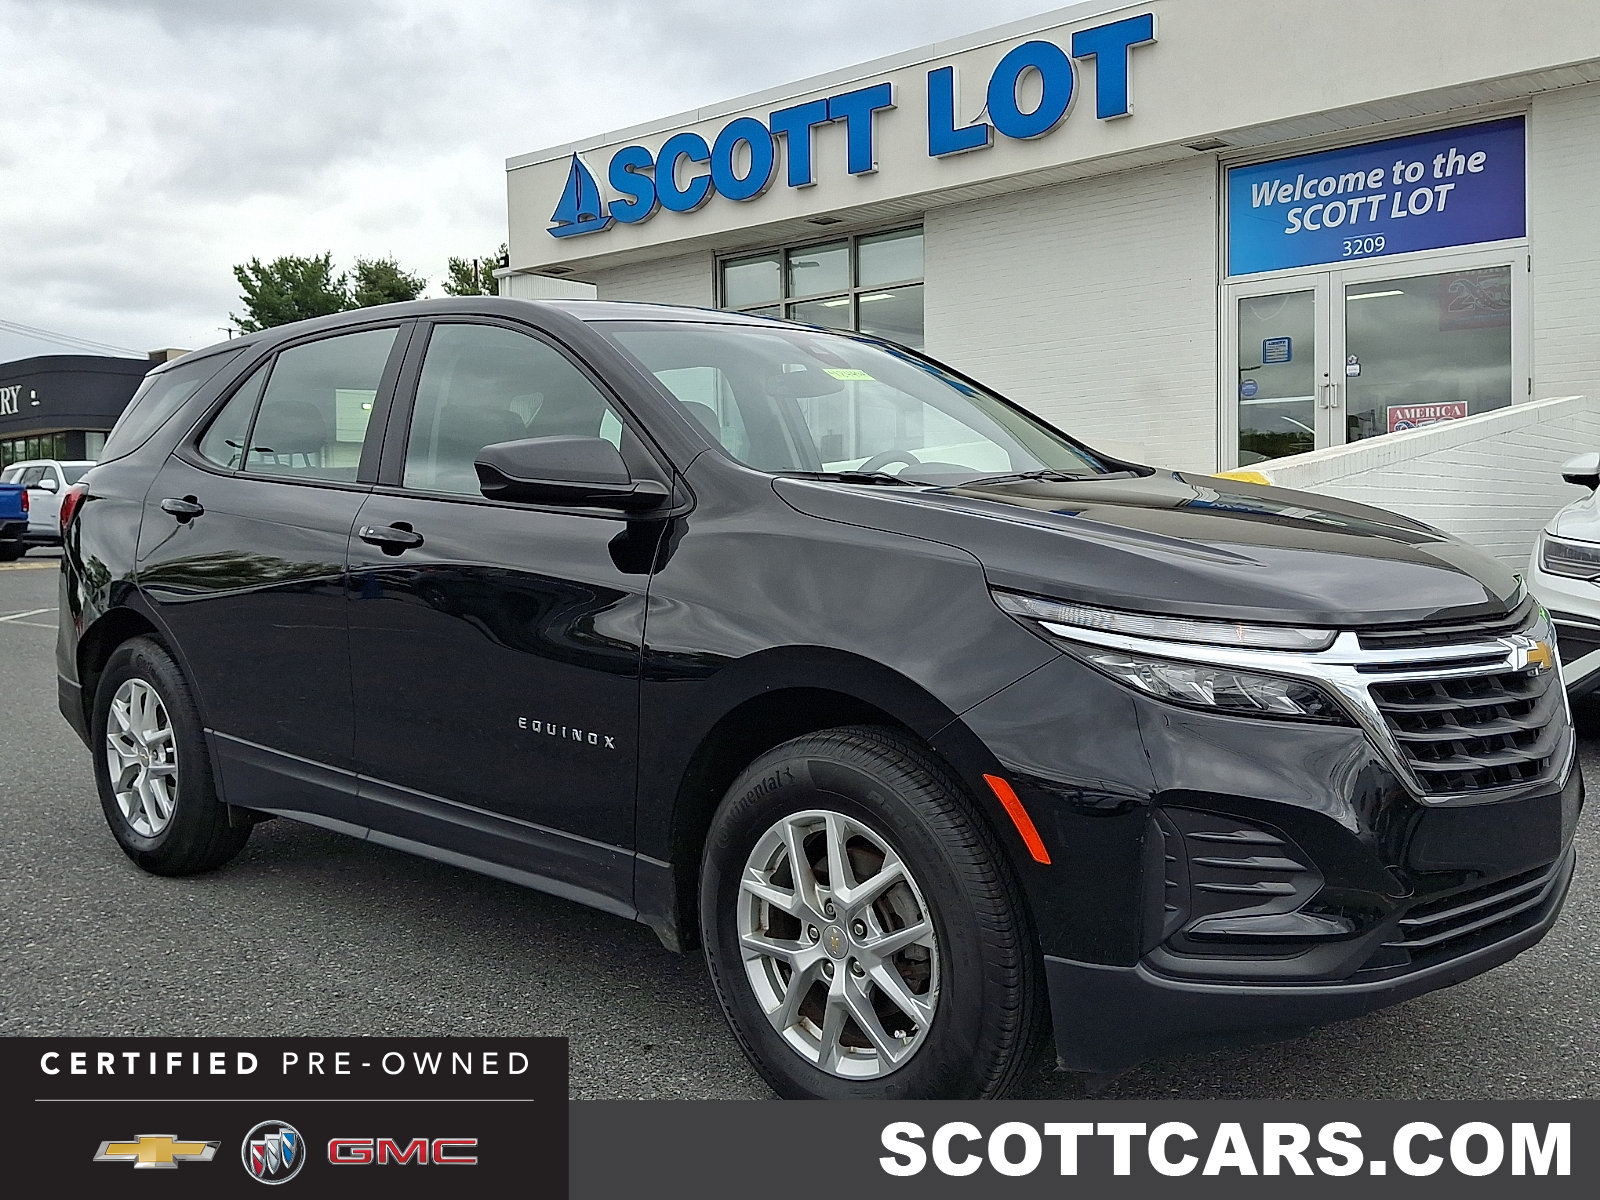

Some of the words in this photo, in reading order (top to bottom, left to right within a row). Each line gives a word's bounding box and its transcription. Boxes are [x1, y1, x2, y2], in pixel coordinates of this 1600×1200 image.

[608, 82, 893, 224] SCOTT
[927, 13, 1154, 157] LOT
[1251, 167, 1384, 209] Welcome
[1392, 160, 1426, 186] to
[1432, 146, 1487, 180] the
[1283, 193, 1388, 235] SCOTT
[1389, 183, 1456, 220] LOT
[1341, 235, 1386, 257] 3209
[1393, 404, 1463, 420] AMERICA
[517, 715, 615, 750] EQUINOX
